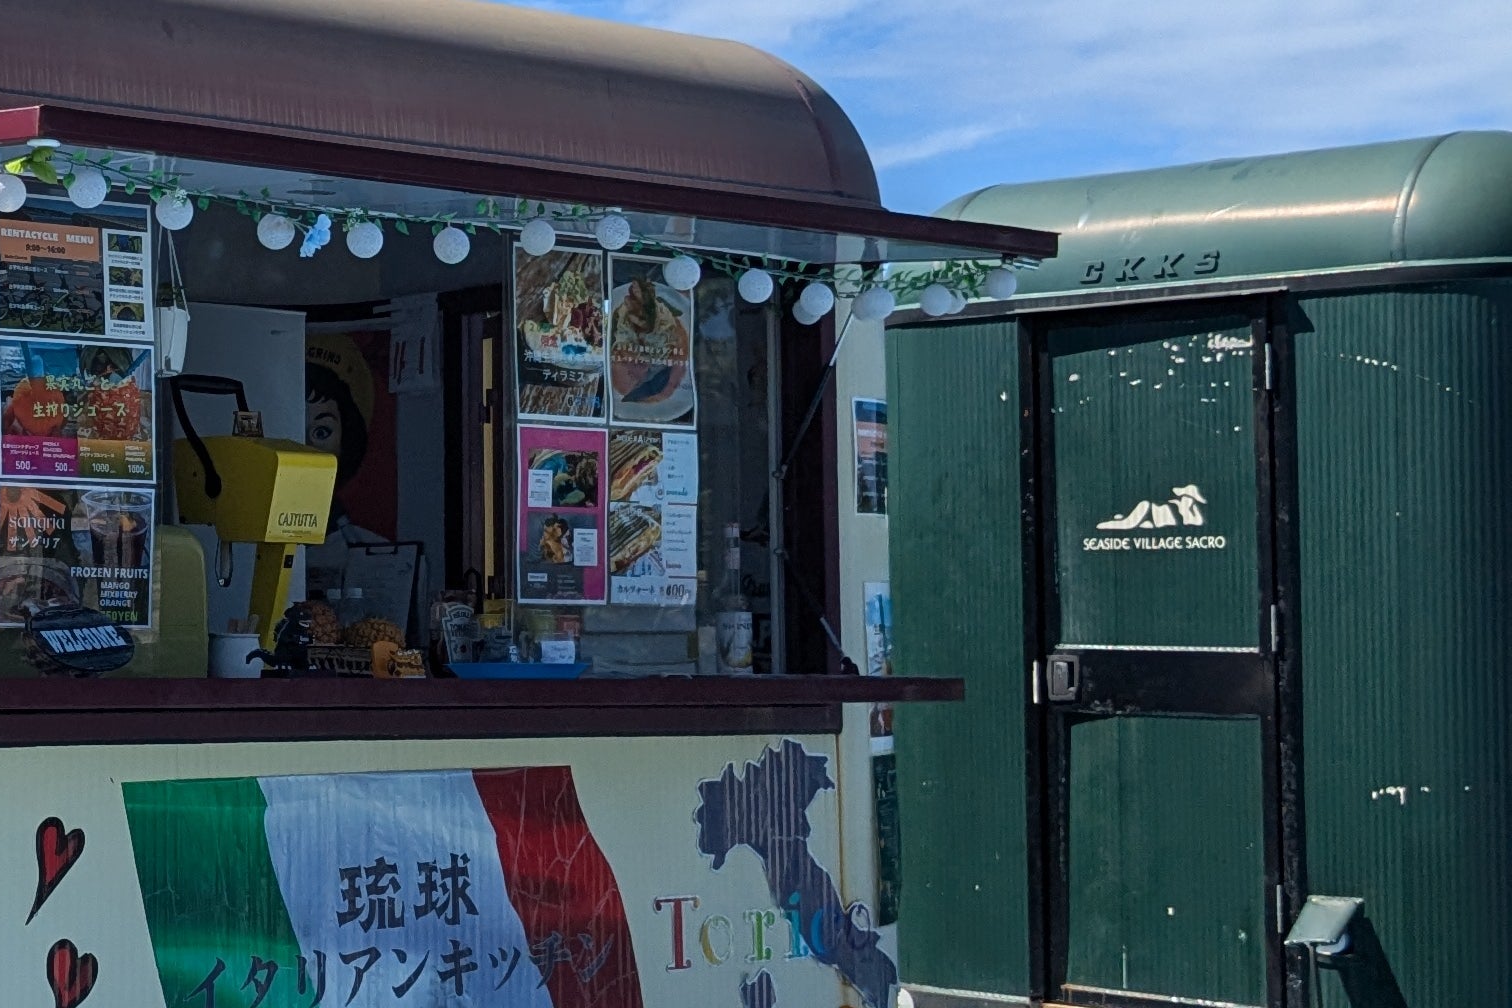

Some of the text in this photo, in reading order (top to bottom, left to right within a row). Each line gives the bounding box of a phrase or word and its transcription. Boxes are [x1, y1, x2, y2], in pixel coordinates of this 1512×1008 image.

[0, 227, 94, 244] RENTACYCLE MENU
[45, 373, 111, 391] 果実丸ごと
[542, 368, 586, 382] ティラミス
[33, 402, 129, 417] 生搾りジュース
[15, 460, 31, 471] 500
[54, 462, 68, 472] 500
[92, 463, 110, 472] 1000
[128, 464, 145, 474] 1000
[8, 514, 65, 534] sangria
[9, 536, 61, 549] サングリア
[1083, 536, 1226, 550] SEASIDE VILLAGE SACRO
[70, 566, 149, 579] FROZEN FRUITS
[100, 582, 130, 590] MANGO
[99, 599, 132, 607] ORANGE
[40, 625, 128, 654] WELCOME
[336, 852, 479, 934] 琉球
[187, 930, 616, 1008] イタリアンキッチン
